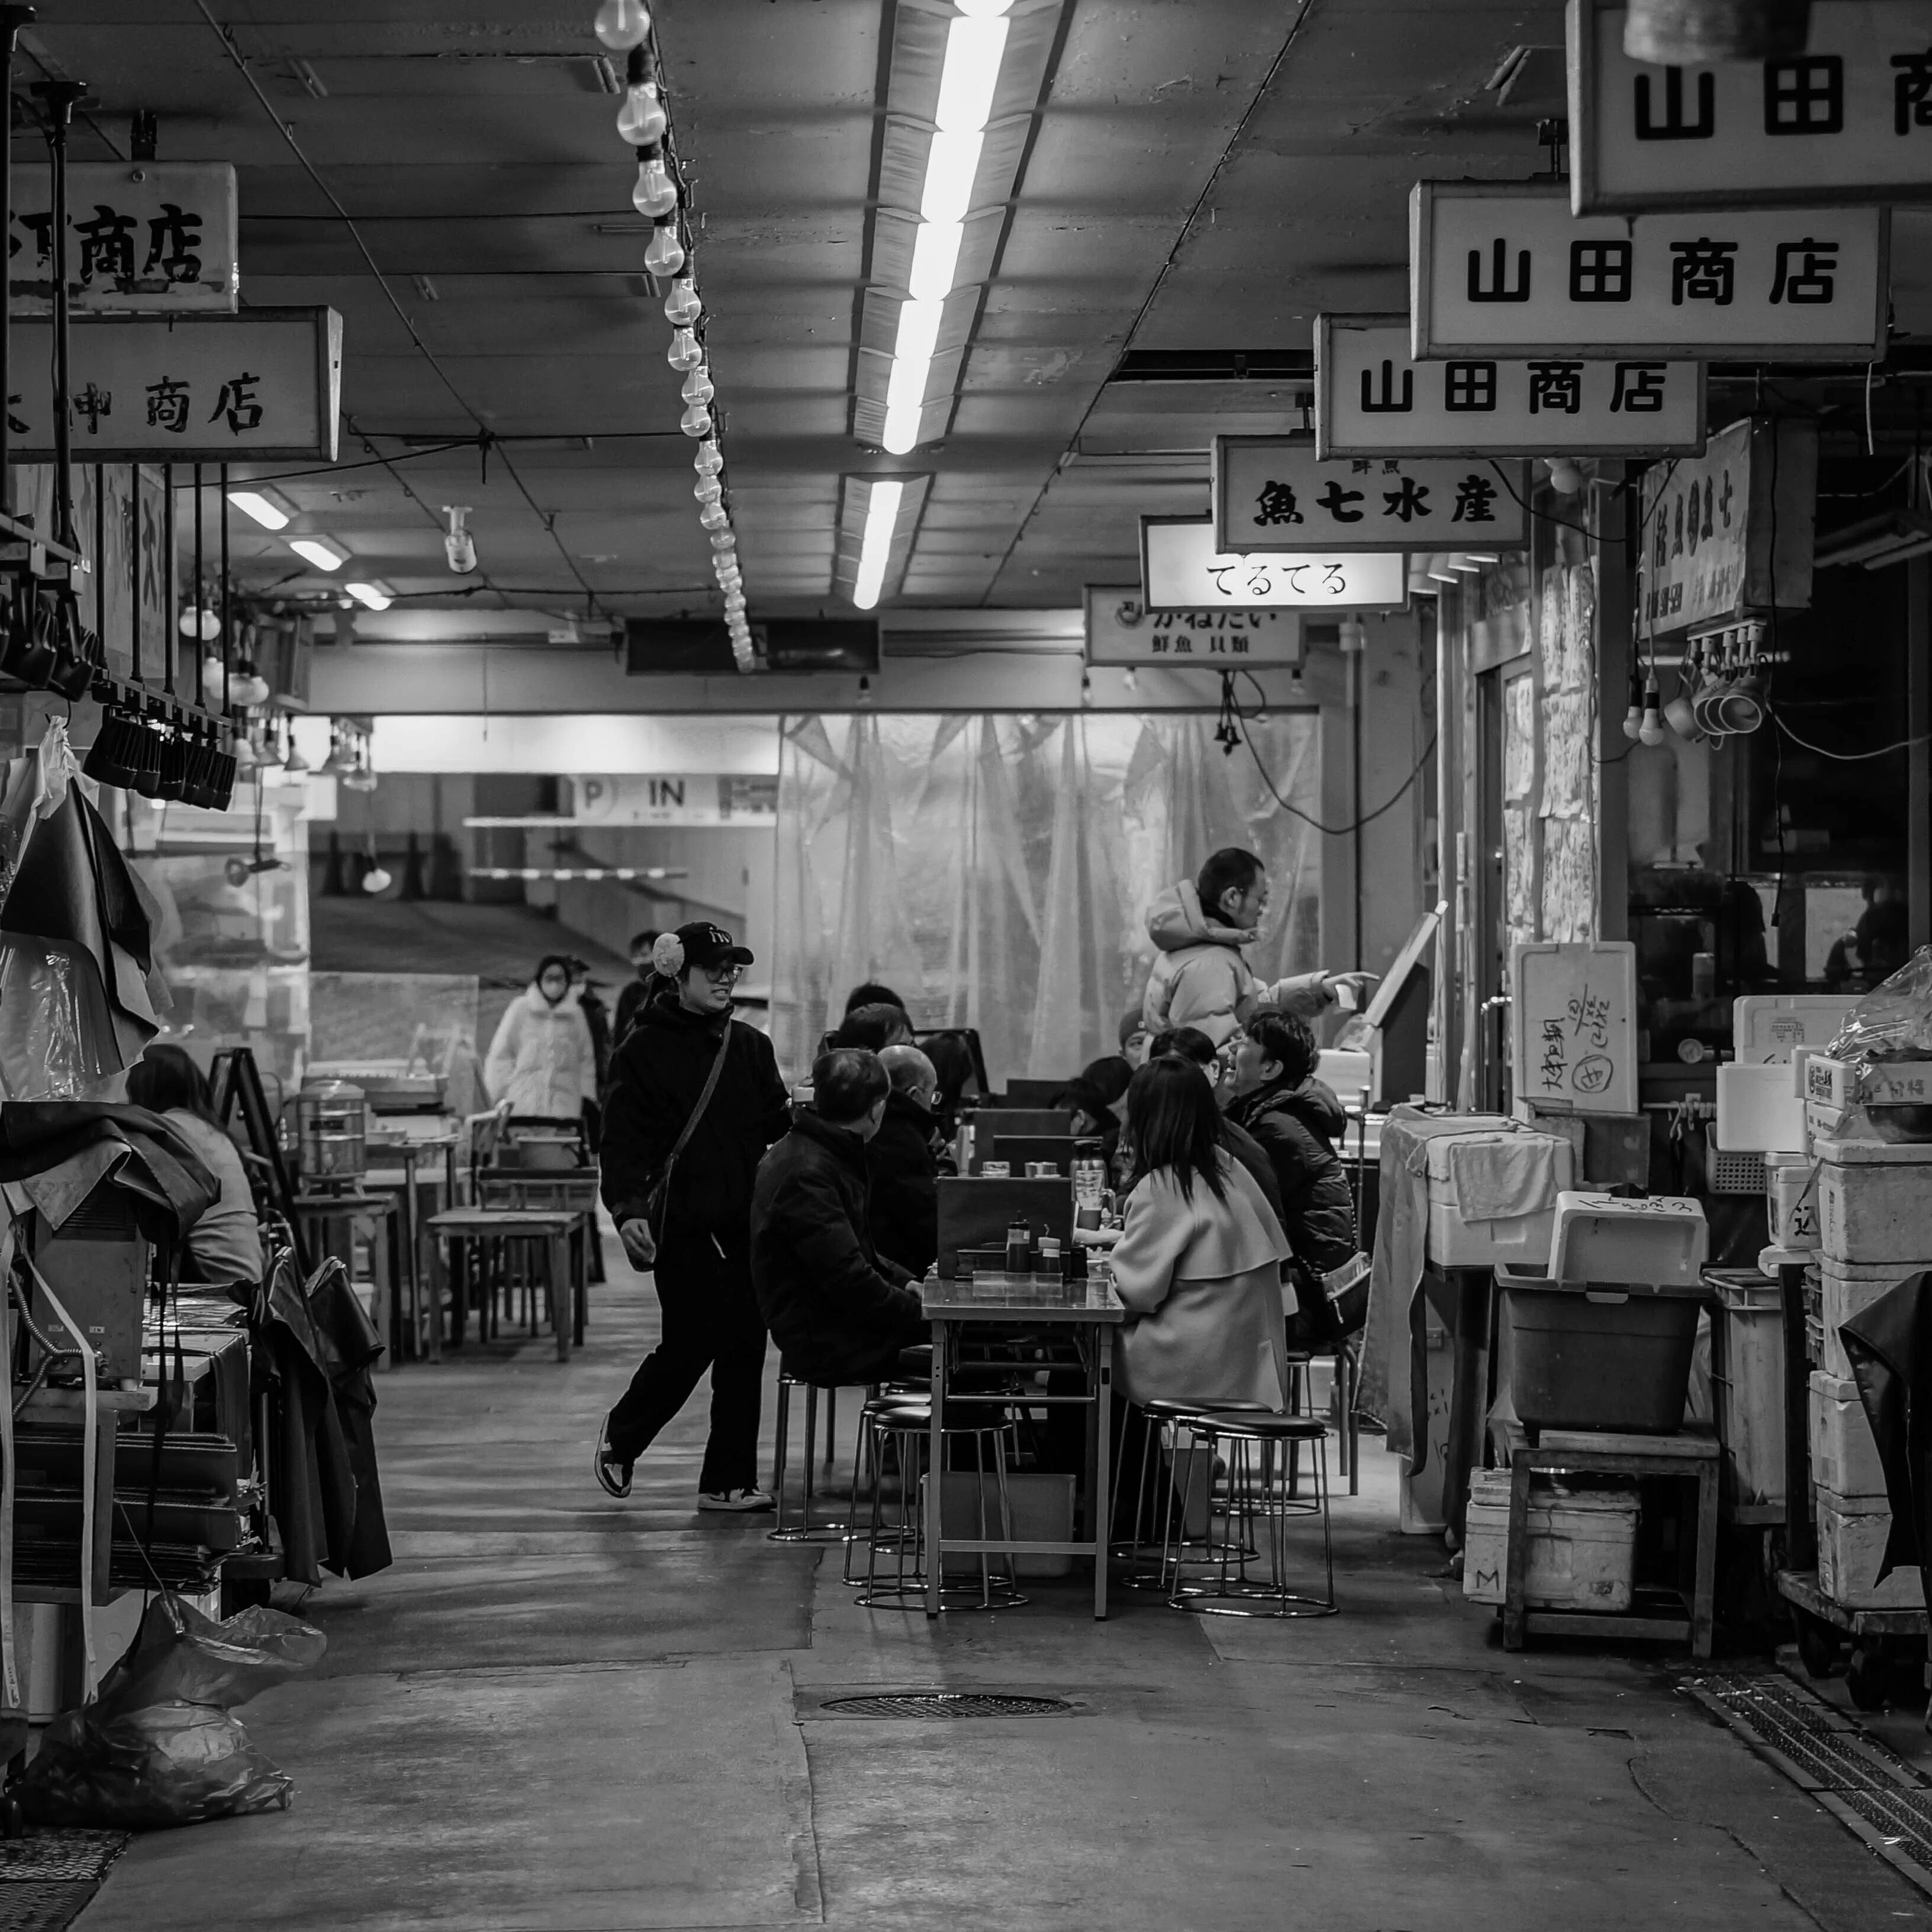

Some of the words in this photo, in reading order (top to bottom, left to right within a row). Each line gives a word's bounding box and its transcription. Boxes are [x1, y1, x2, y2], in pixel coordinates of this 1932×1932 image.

[1467, 237, 1840, 306] 山田商店
[1361, 360, 1668, 414] 山田商店
[1253, 474, 1498, 526] 魚七水産
[1206, 564, 1347, 597] てるてる
[648, 778, 685, 807] IN
[1476, 1569, 1500, 1591] M
